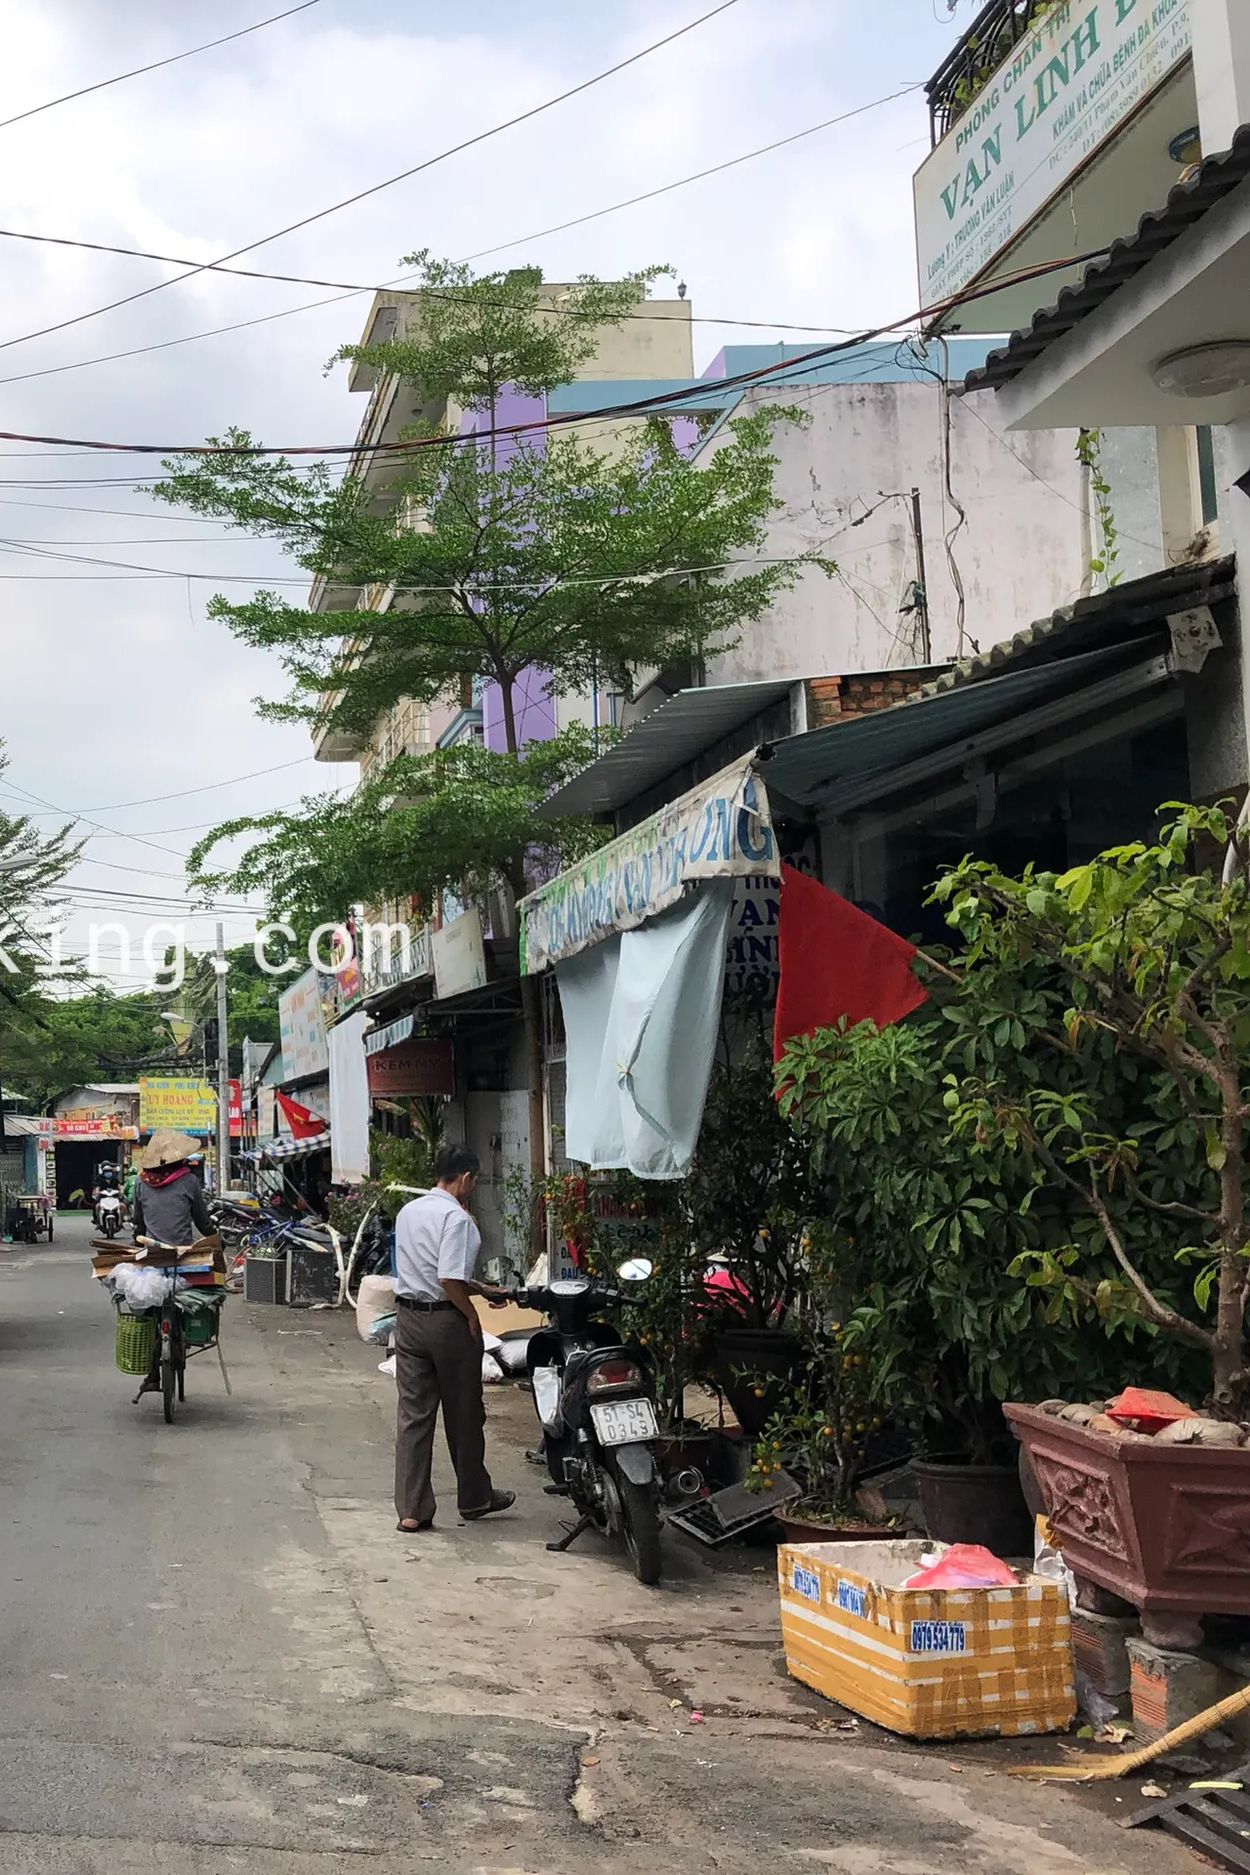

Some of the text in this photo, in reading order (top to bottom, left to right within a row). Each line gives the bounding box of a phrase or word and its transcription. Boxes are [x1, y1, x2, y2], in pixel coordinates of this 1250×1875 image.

[940, 5, 1101, 220] VẠN LINH
[955, 87, 1000, 153] PHÒNG
[602, 1402, 644, 1423] 51-S4
